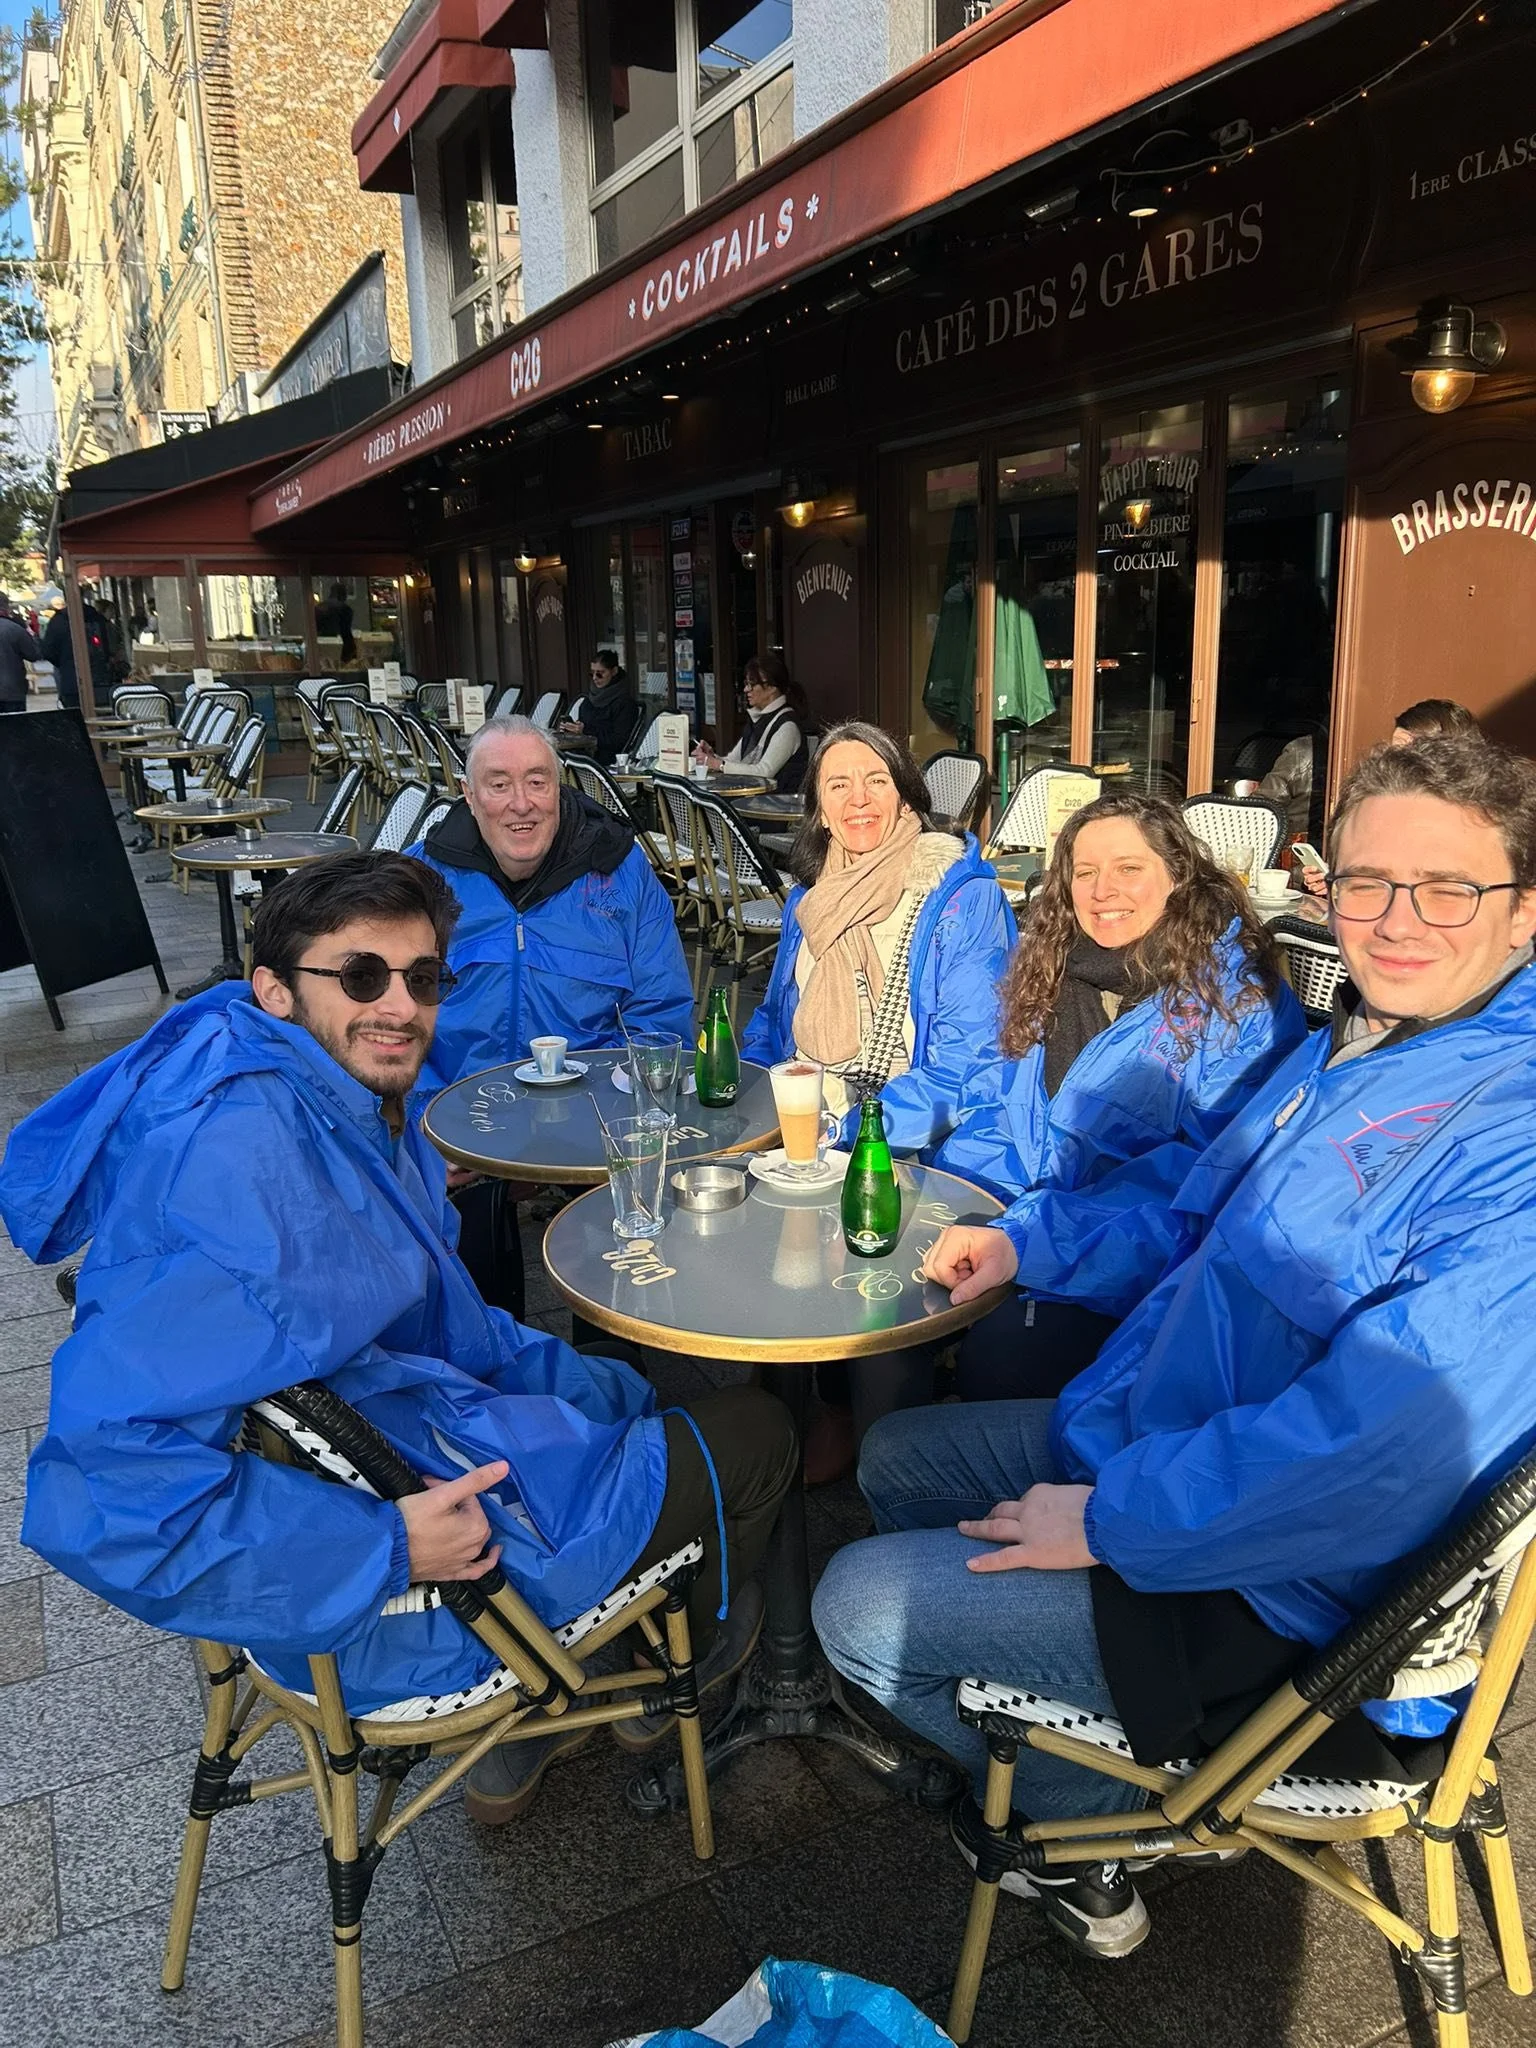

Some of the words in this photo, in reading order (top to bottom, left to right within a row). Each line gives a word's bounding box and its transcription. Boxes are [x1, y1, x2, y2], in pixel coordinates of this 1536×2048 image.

[642, 197, 794, 320] COCKTAILS
[896, 300, 976, 373] CAFÉ
[985, 276, 1057, 347] DES
[1068, 261, 1088, 320] 2
[1100, 201, 1263, 307] GARES
[785, 382, 808, 405] HALL
[367, 429, 397, 465] BIÈRES
[400, 401, 445, 448] PRESSION
[622, 416, 672, 461] TABAC
[1102, 457, 1149, 503] HAPPY
[1156, 453, 1199, 494] HOUR
[1150, 513, 1191, 536] BIÈRE
[1391, 479, 1536, 555] BRASSERI
[796, 563, 853, 604] BIENVENUE
[1113, 551, 1179, 572] COCKTAIL
